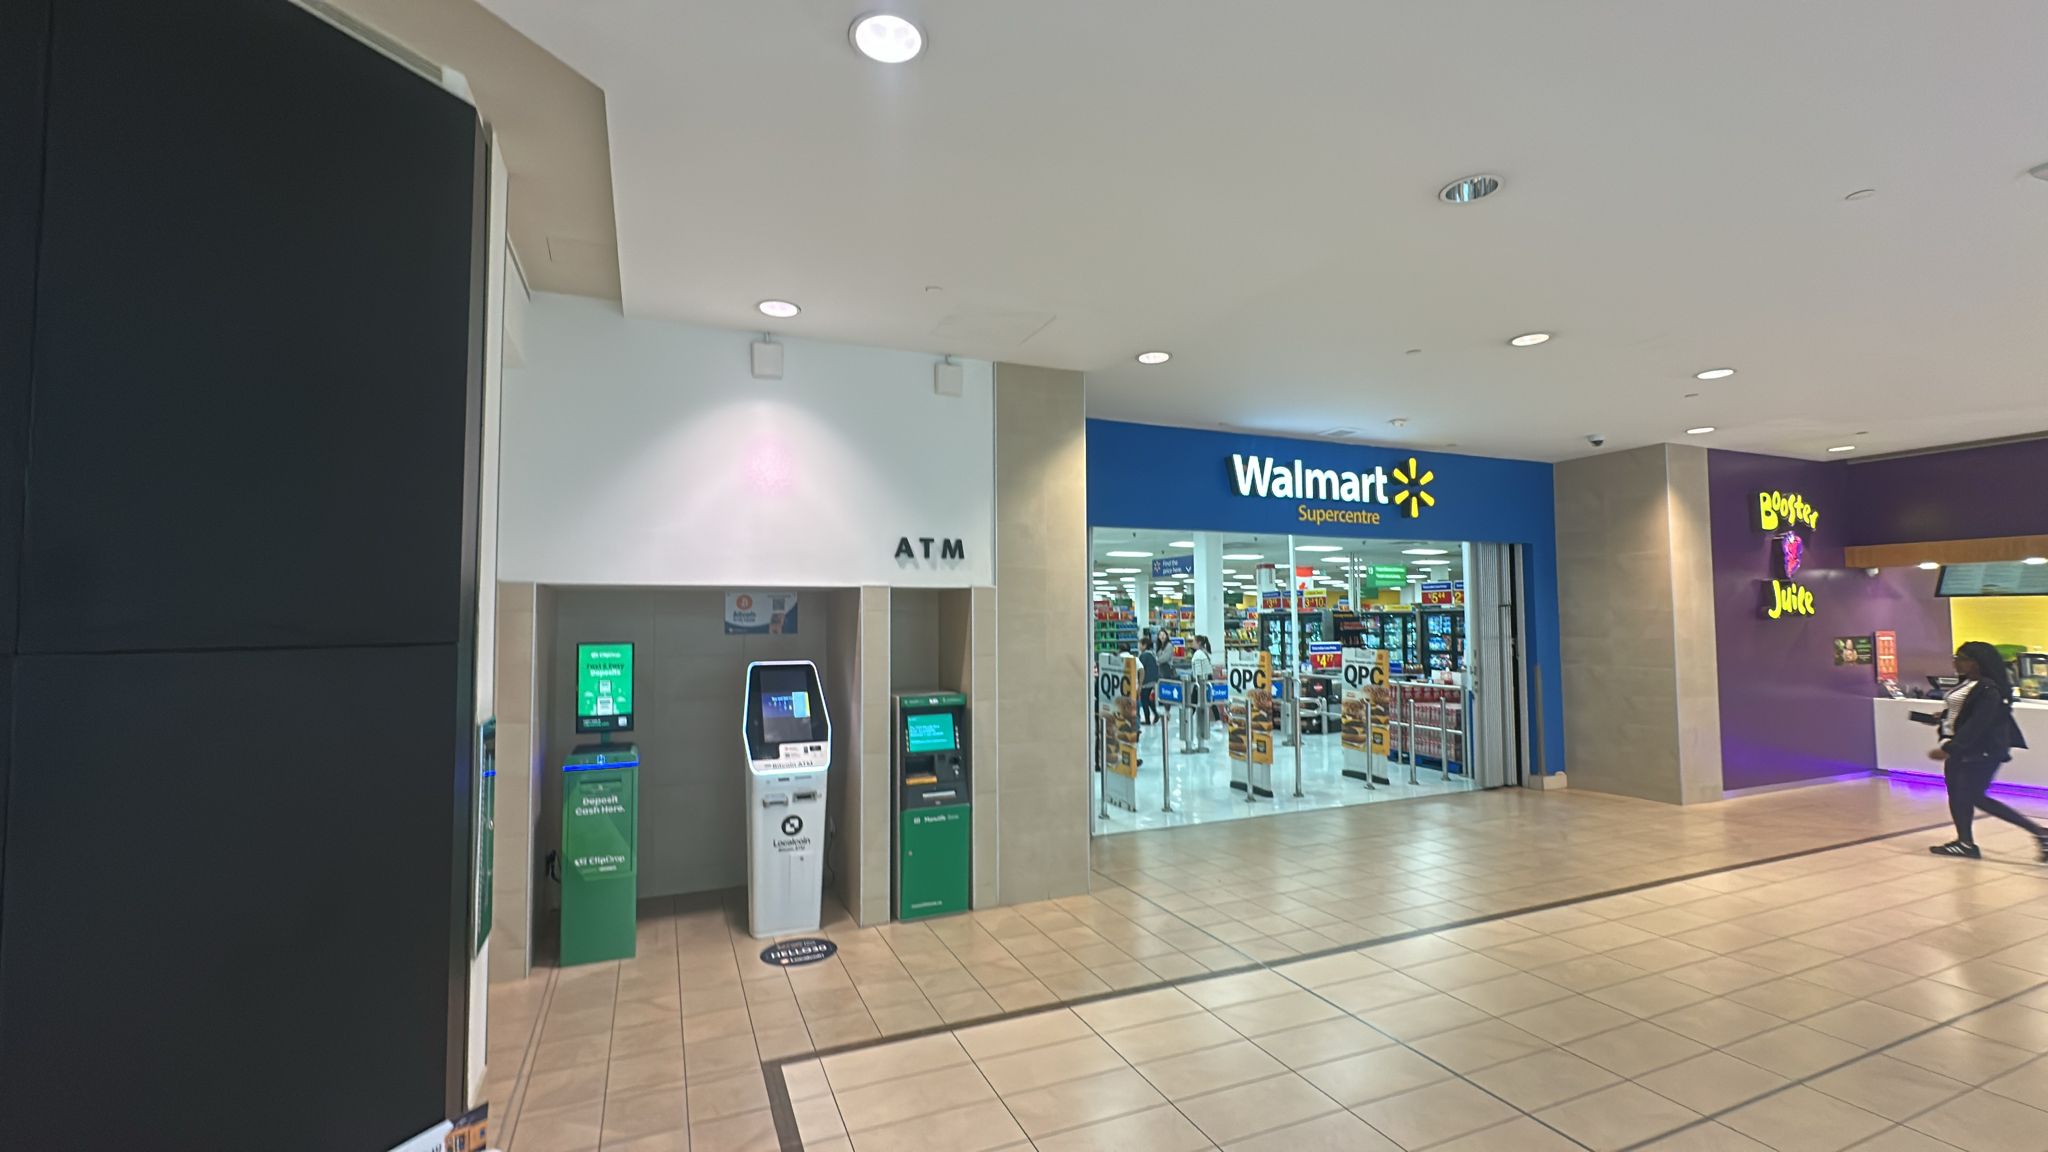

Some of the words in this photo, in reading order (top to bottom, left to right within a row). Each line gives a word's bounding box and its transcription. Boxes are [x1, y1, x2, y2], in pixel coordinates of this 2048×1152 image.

[1232, 453, 1389, 504] Walmart
[1298, 504, 1380, 525] Supercentre
[1759, 490, 1819, 531] Booster
[894, 536, 965, 560] ATM
[1767, 579, 1815, 619] Juice
[1100, 672, 1132, 700] QPC
[1229, 668, 1266, 694] QPC
[1344, 664, 1384, 689] QPC
[575, 806, 600, 816] Cash
[582, 795, 619, 806] Deposit
